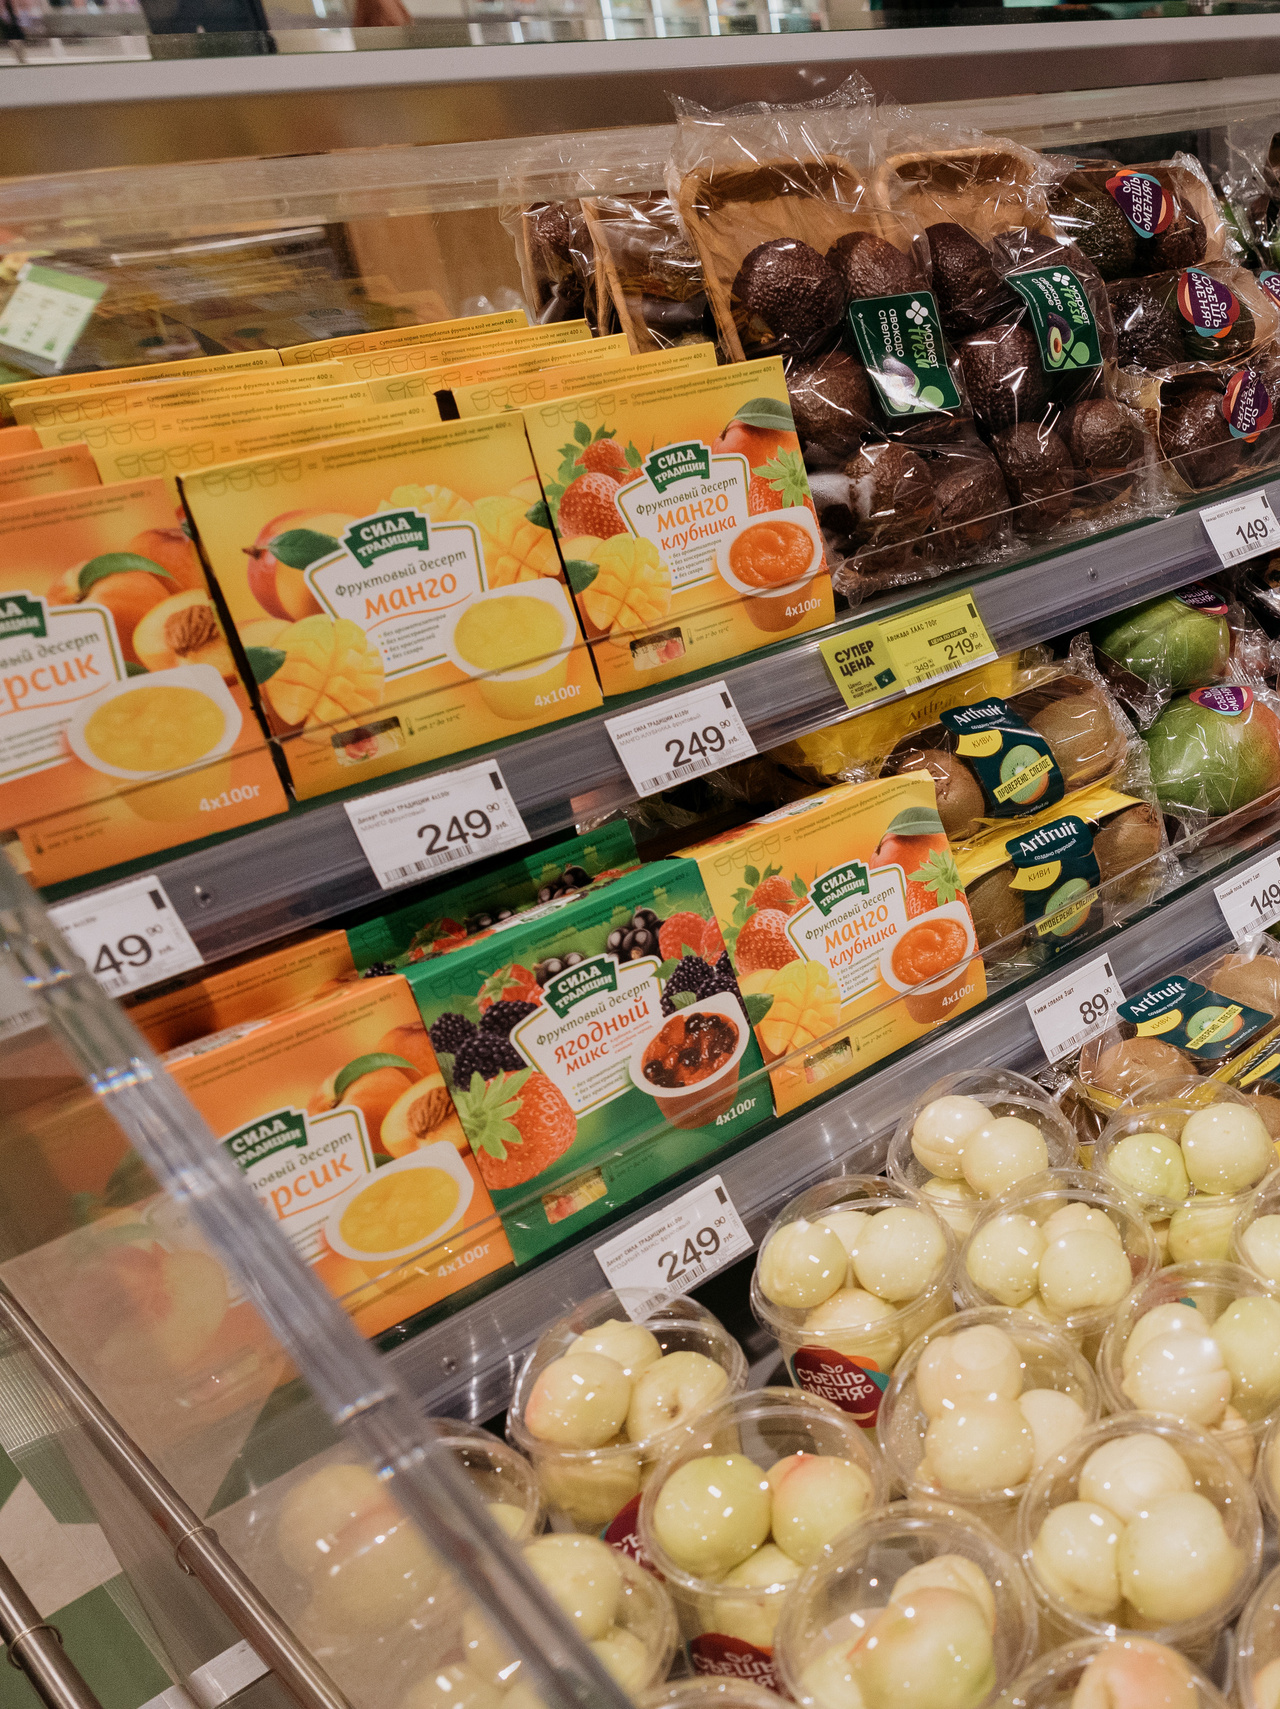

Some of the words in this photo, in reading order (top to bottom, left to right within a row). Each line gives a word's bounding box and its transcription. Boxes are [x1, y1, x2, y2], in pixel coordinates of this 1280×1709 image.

[1131, 176, 1142, 224] СЪЕШЬ
[1031, 278, 1055, 306] спелое
[1038, 277, 1064, 311] авокадо
[1201, 274, 1223, 327] СЪЕШЬ
[878, 309, 893, 353] спелое
[888, 308, 905, 357] авокадо
[655, 461, 706, 484] ТРАДИЦИИ
[657, 448, 697, 469] СИЛА
[636, 487, 699, 517] Фруктовый
[700, 476, 738, 495] десерт
[656, 493, 729, 533] манго
[357, 531, 424, 556] ТРАДИЦИИ
[360, 517, 411, 541] СИЛА
[661, 515, 737, 551] клубника
[1236, 518, 1268, 544] 149
[335, 563, 417, 597] Фруктовый
[418, 550, 467, 572] десерт
[365, 573, 457, 620] манго
[38, 633, 100, 659] десерт
[834, 640, 874, 664] СУПЕР
[886, 631, 910, 643] Авокадо
[944, 637, 974, 660] 219
[969, 631, 978, 640] 99
[0, 654, 100, 711] рсик
[839, 656, 876, 677] ЦЕНА
[914, 662, 930, 673] 349
[953, 703, 1005, 727] Artfruit
[665, 726, 725, 768] 249
[719, 719, 731, 729] 90
[971, 734, 993, 749] КИВИ
[1030, 758, 1051, 779] СПЕЛОЕ
[417, 809, 492, 856] 249
[486, 802, 500, 814] 90
[1019, 821, 1079, 857] Artfruit
[1034, 849, 1055, 861] создано
[1055, 838, 1077, 854] природой
[821, 868, 856, 893] СИЛА
[1027, 867, 1051, 883] КИВИ
[819, 879, 866, 906] ТРАДИЦИИ
[805, 903, 862, 940] Фруктовый
[861, 886, 896, 911] десерт
[824, 904, 889, 954] манго
[93, 934, 153, 975] 49
[829, 922, 898, 969] клубника
[555, 974, 613, 1010] ТРАДИЦИИ
[557, 965, 602, 994] СИЛА
[536, 1003, 607, 1046] Фруктовый
[607, 979, 650, 1007] десерт
[1079, 993, 1109, 1025] 89
[1103, 986, 1112, 997] 90
[1129, 981, 1187, 1016] Artfruit
[1151, 1015, 1172, 1030] КИВИ
[565, 1042, 610, 1076] микс
[231, 1118, 287, 1152] СИЛА
[298, 1132, 353, 1165] десерт
[658, 1227, 721, 1283] 249
[713, 1215, 726, 1228] 90
[796, 1368, 866, 1387] СЪЕШЬ
[809, 1383, 866, 1401] МЕНЯ
